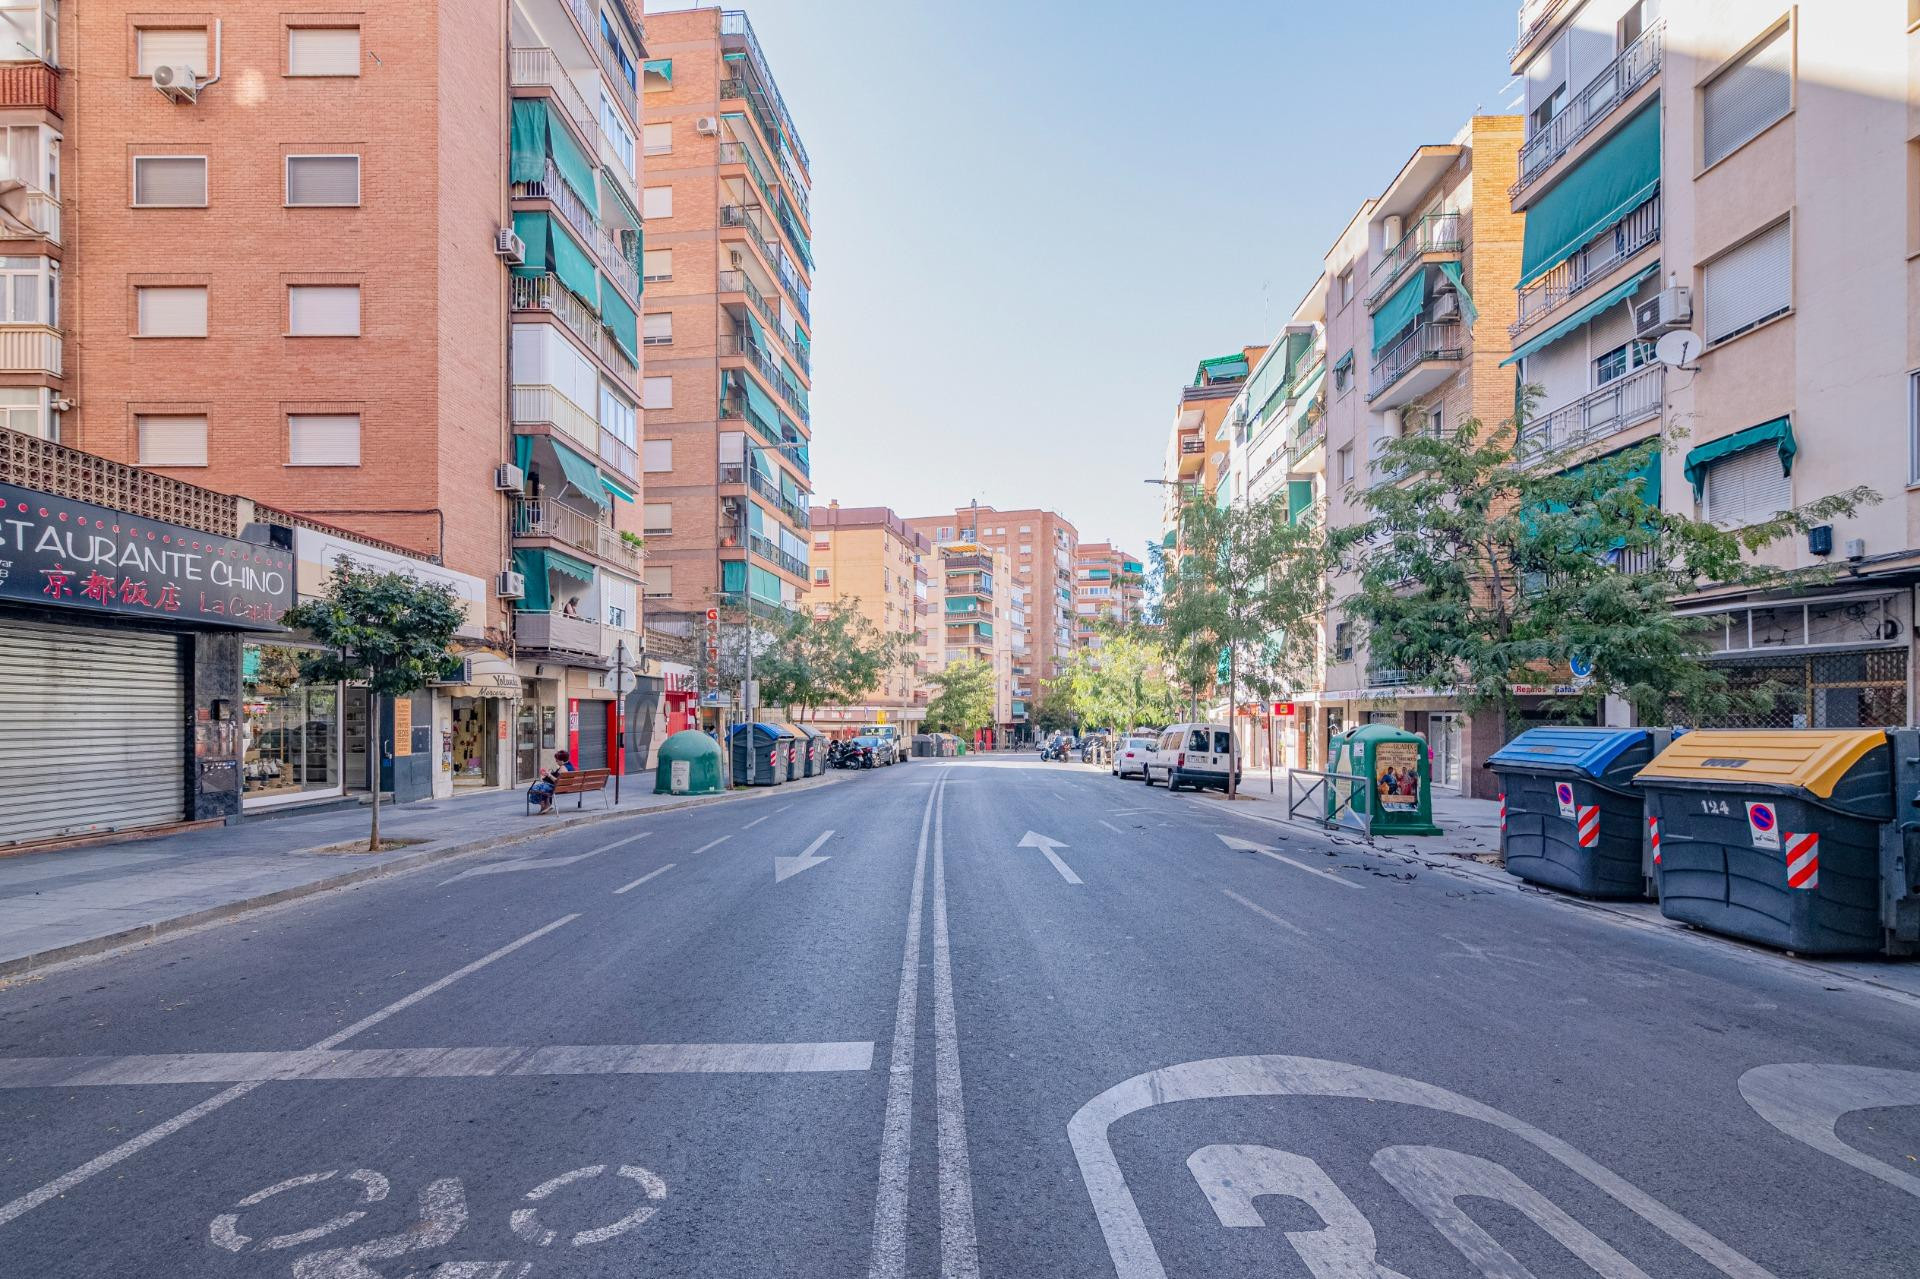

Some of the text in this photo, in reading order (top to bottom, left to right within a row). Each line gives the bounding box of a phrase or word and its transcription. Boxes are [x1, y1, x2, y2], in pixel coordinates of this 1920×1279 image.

[39, 563, 181, 612] 京都饭店
[210, 560, 284, 595] CHINO
[200, 591, 289, 623] La Capita
[1516, 685, 1546, 694] Regalos
[1700, 799, 1729, 815] 124
